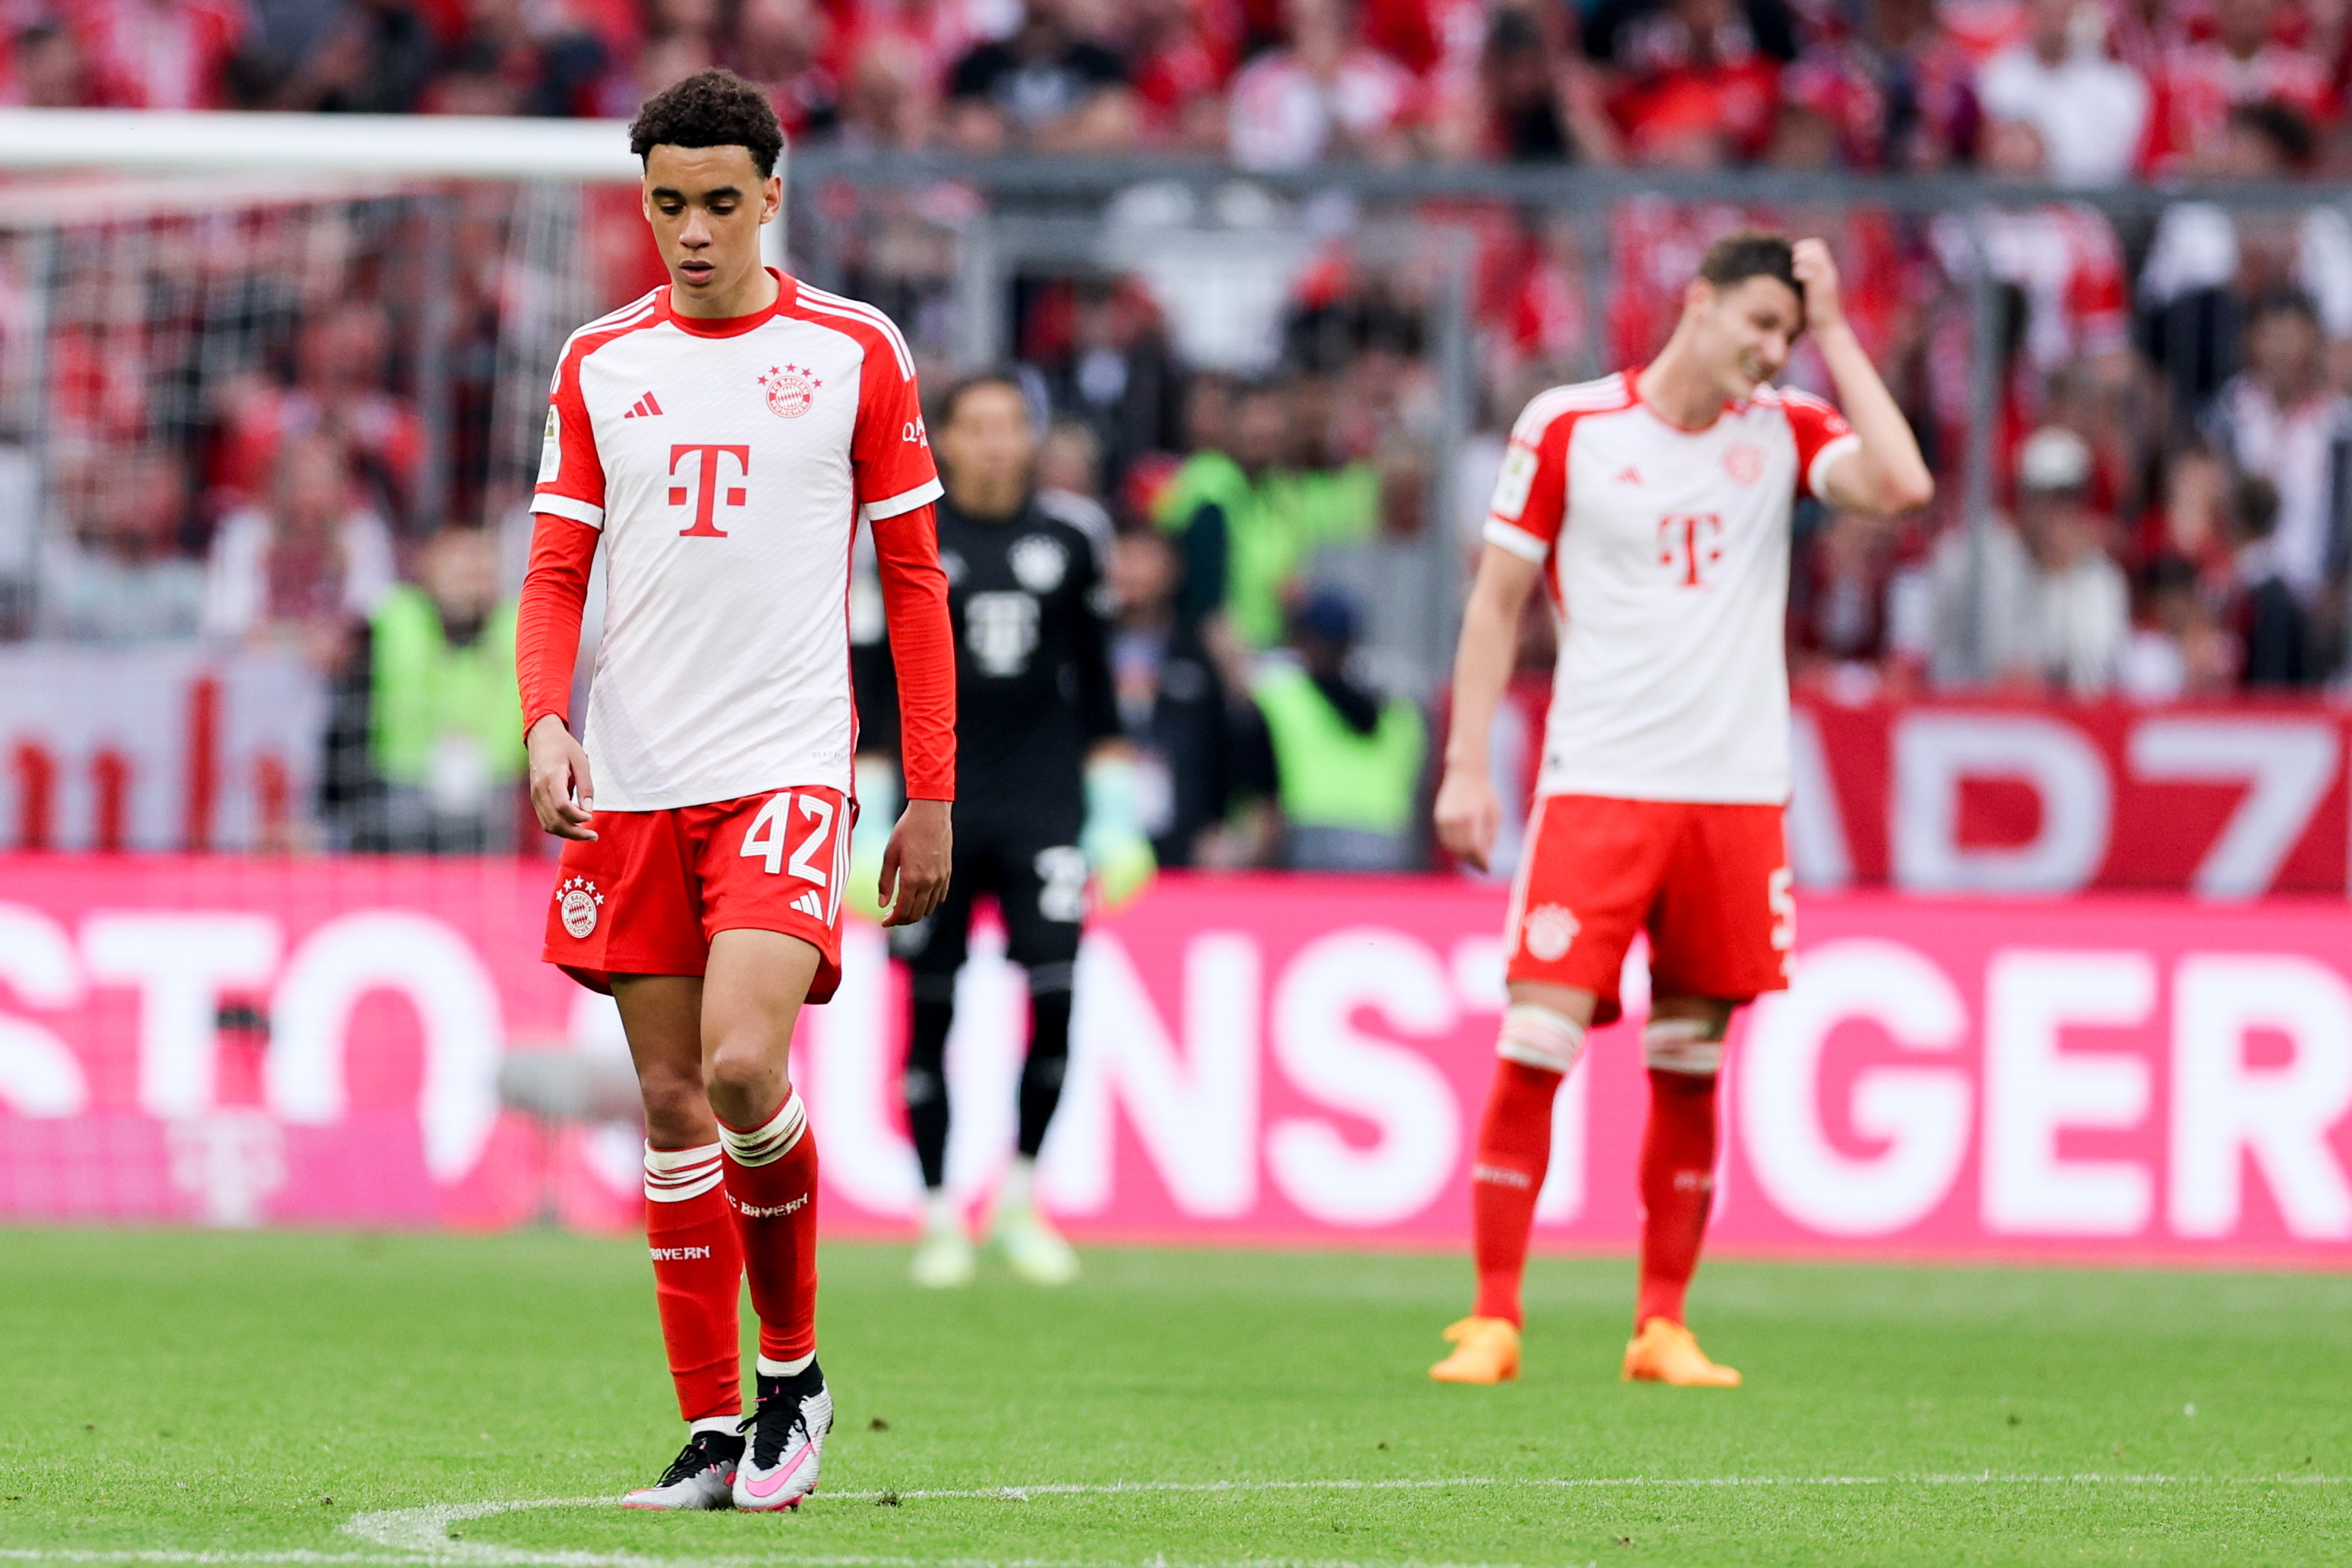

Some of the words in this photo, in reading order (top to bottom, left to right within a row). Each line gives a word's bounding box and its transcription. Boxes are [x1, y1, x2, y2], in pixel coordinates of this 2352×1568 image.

[781, 378, 810, 394] BAYERN
[668, 445, 750, 538] T
[739, 791, 834, 887] 42
[570, 894, 592, 912] BAYERN
[741, 1192, 808, 1218] BAYERN
